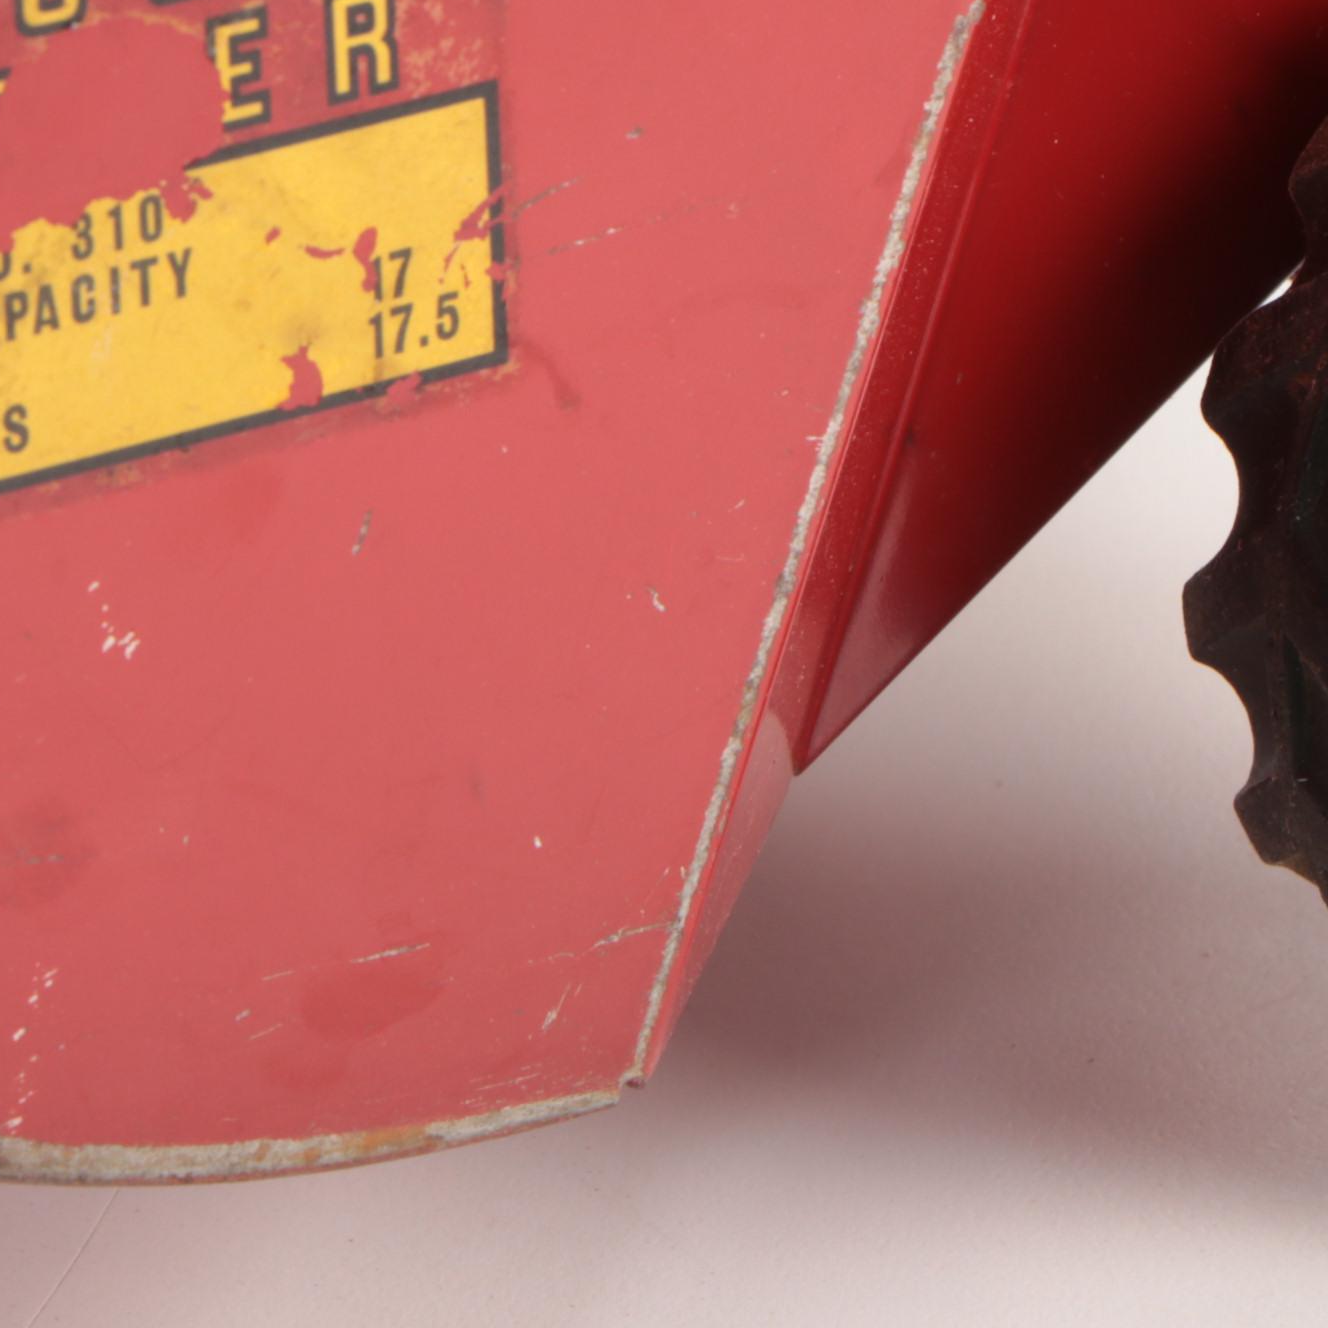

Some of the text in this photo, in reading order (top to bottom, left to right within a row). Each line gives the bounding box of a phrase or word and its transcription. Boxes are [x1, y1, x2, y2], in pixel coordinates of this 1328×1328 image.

[71, 193, 163, 260] 310
[372, 247, 413, 303] 17
[369, 291, 460, 359] 17.5
